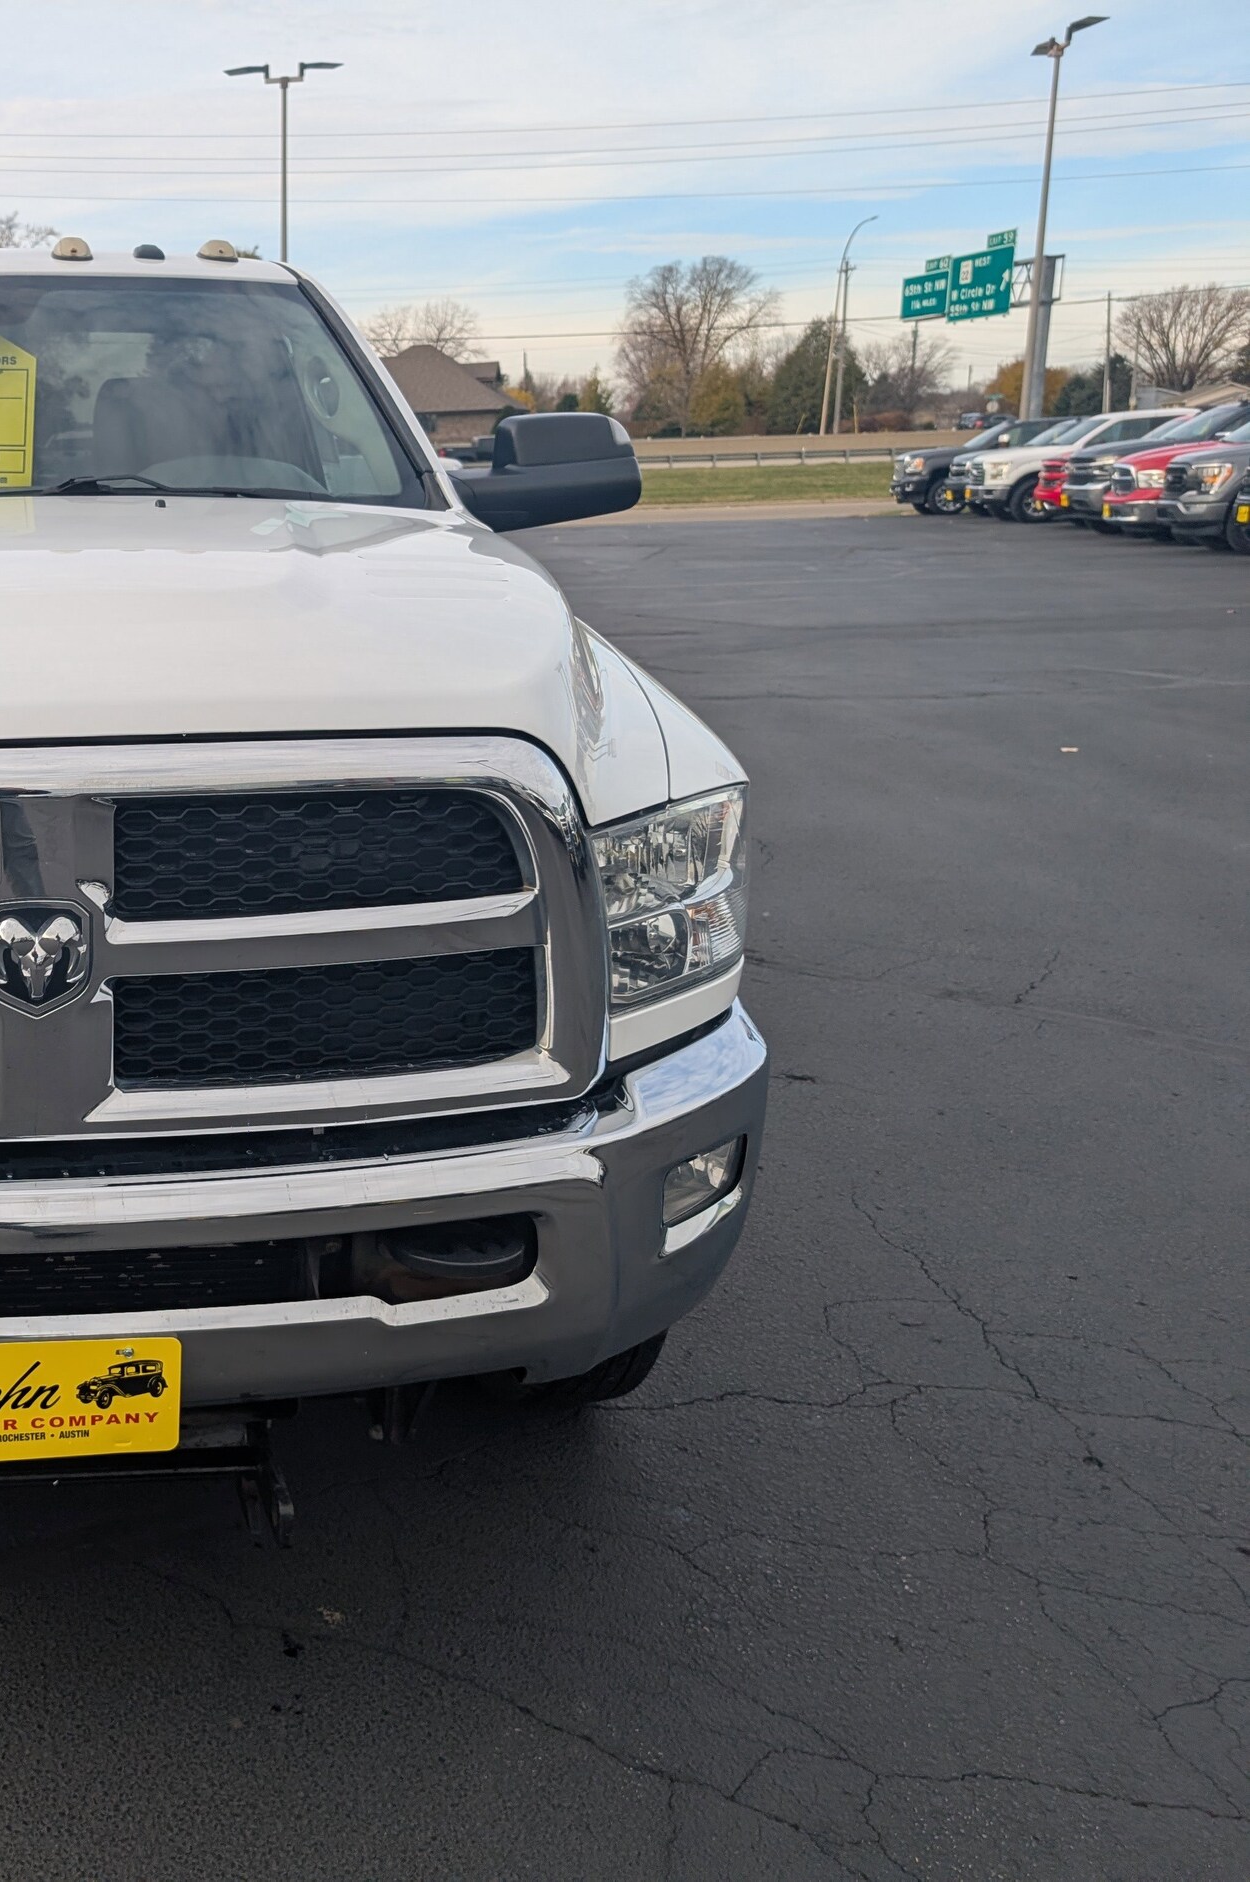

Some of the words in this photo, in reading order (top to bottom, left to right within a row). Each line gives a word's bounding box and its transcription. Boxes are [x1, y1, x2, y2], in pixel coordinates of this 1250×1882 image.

[974, 256, 991, 268] WEST
[961, 270, 970, 281] 22
[904, 283, 922, 297] 65th
[924, 280, 933, 294] St
[934, 278, 947, 291] NW
[960, 287, 984, 300] Circle
[986, 283, 996, 296] Dr
[971, 301, 980, 311] St
[982, 298, 995, 311] NW
[30, 1411, 160, 1429] COMPANY
[59, 1429, 90, 1439] AUSTIN
